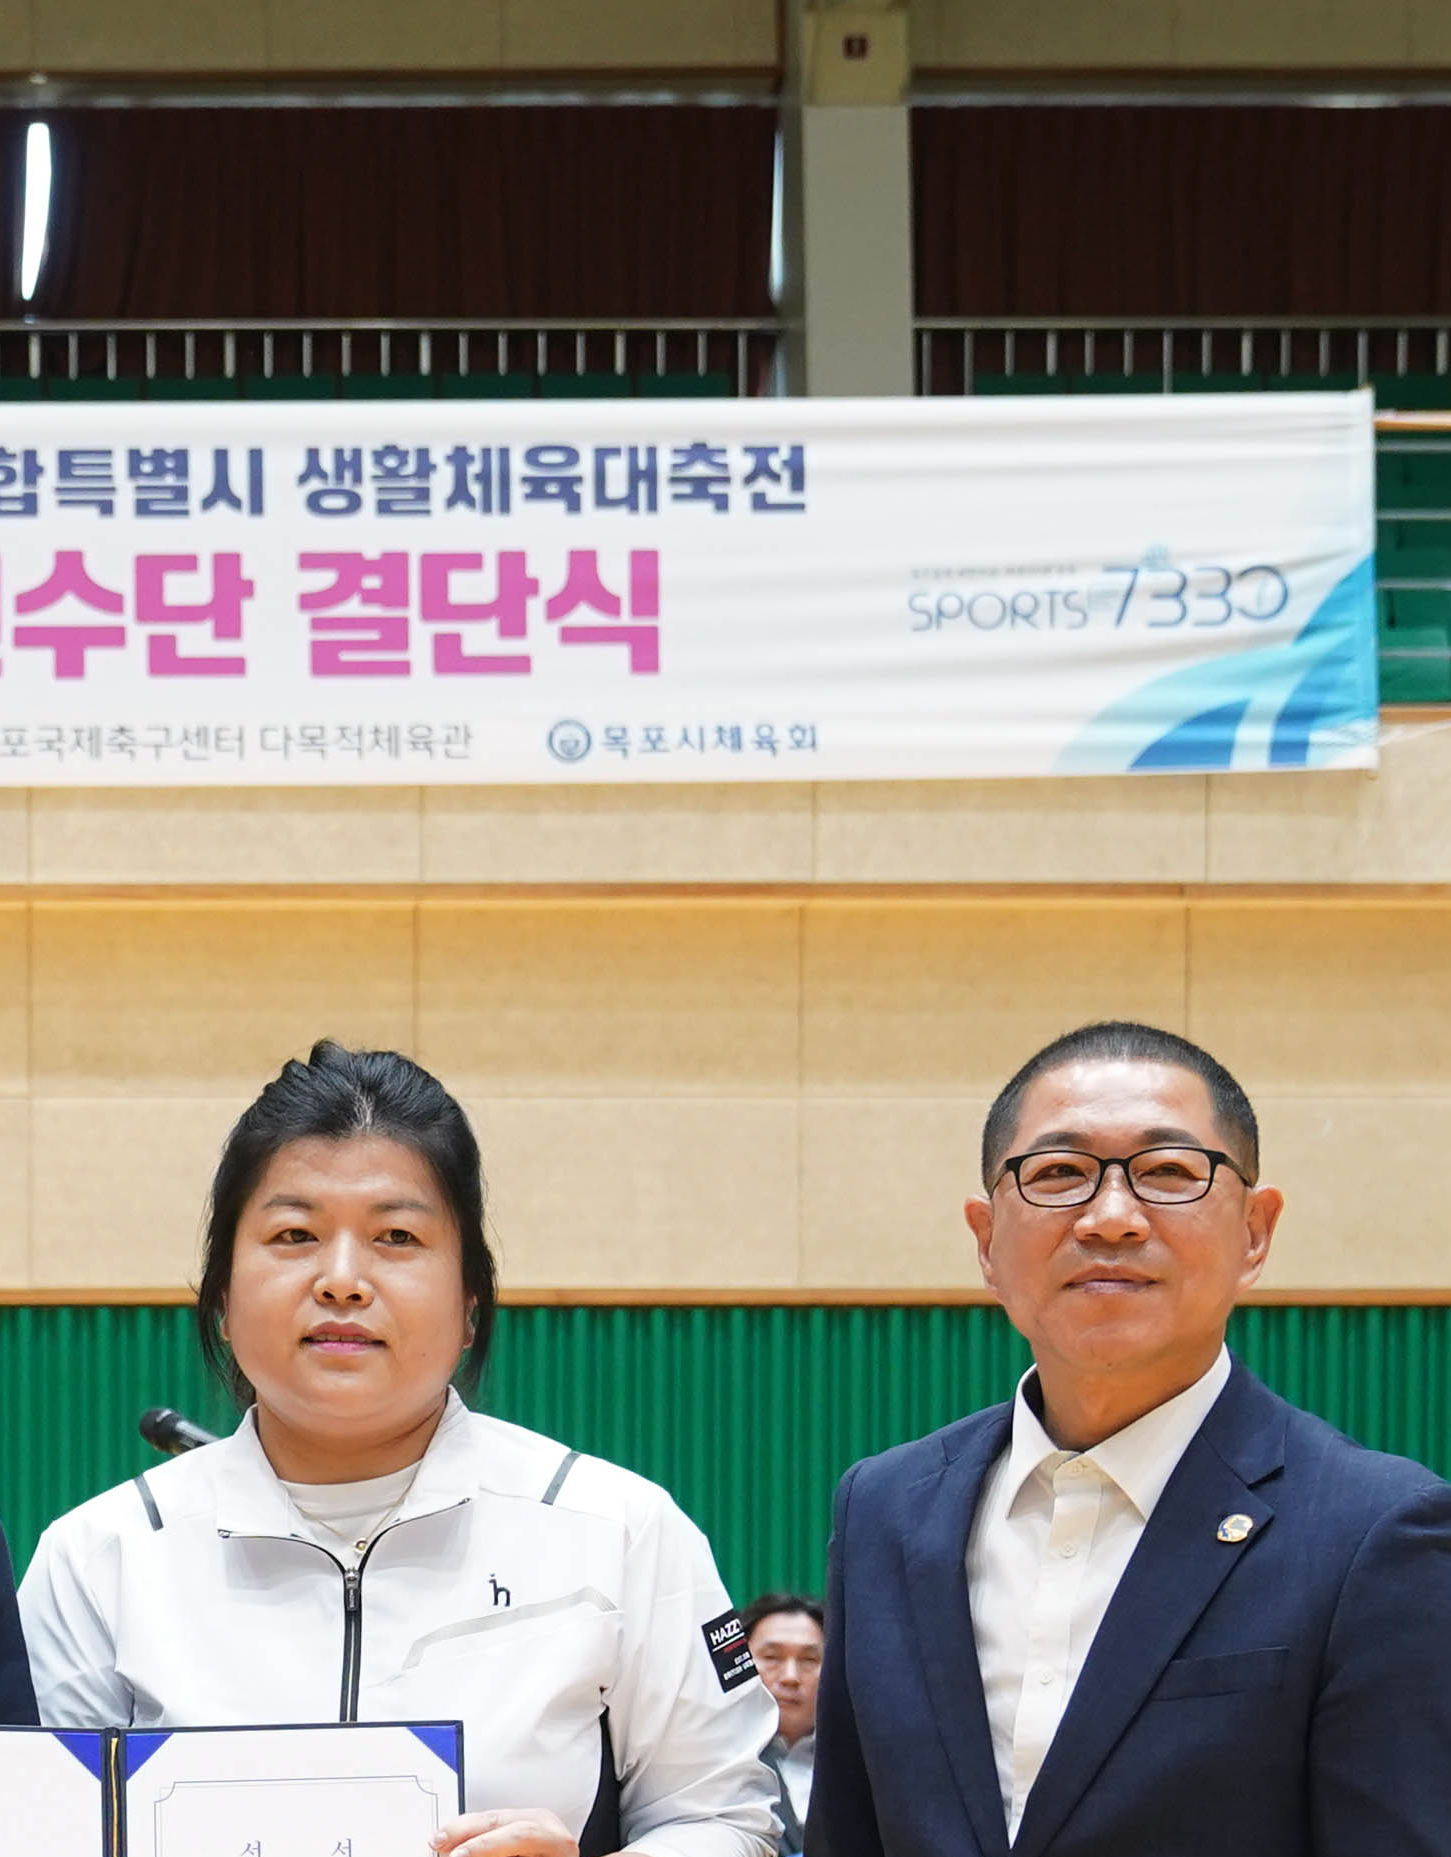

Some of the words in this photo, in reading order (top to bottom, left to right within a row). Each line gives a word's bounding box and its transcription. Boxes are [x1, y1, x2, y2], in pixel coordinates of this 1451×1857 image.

[297, 441, 807, 518] 생활체육대축전
[297, 549, 660, 679] 결단식
[908, 588, 1089, 632] SPORTS
[1101, 563, 1289, 630] 7330
[259, 722, 474, 761] 다목적체육관
[600, 723, 818, 759] 목포시체육회
